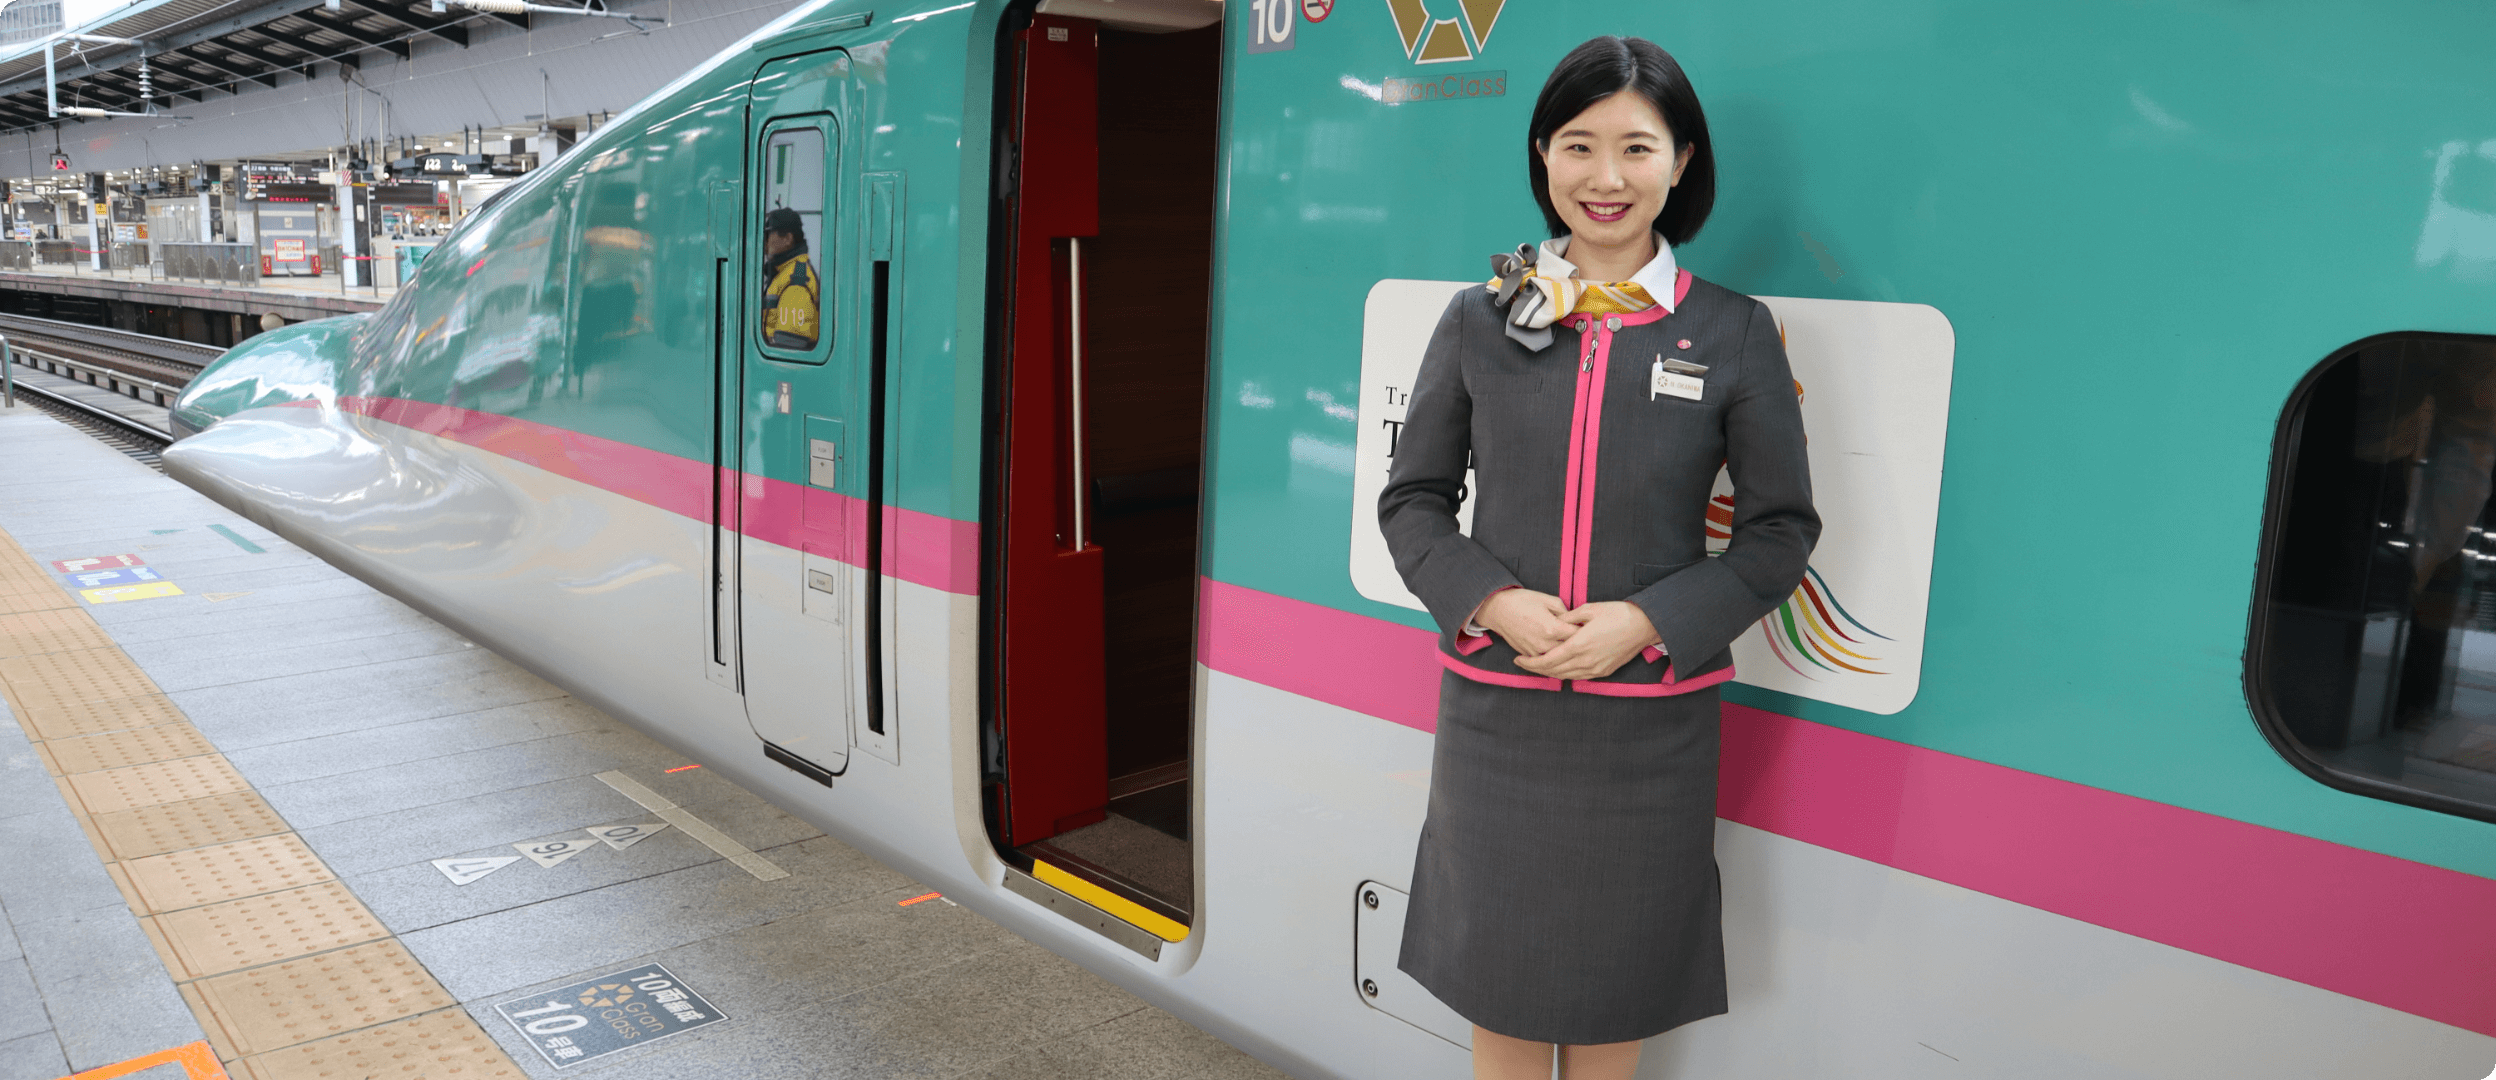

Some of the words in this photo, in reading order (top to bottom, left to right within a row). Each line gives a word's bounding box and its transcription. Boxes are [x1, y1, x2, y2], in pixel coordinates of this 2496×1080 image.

[1252, 0, 1293, 44] 10
[1383, 75, 1505, 101] GranClass
[532, 842, 577, 859] 16
[630, 972, 706, 1023] 10両編成
[601, 1008, 641, 1040] Class
[625, 1002, 665, 1033] Gran
